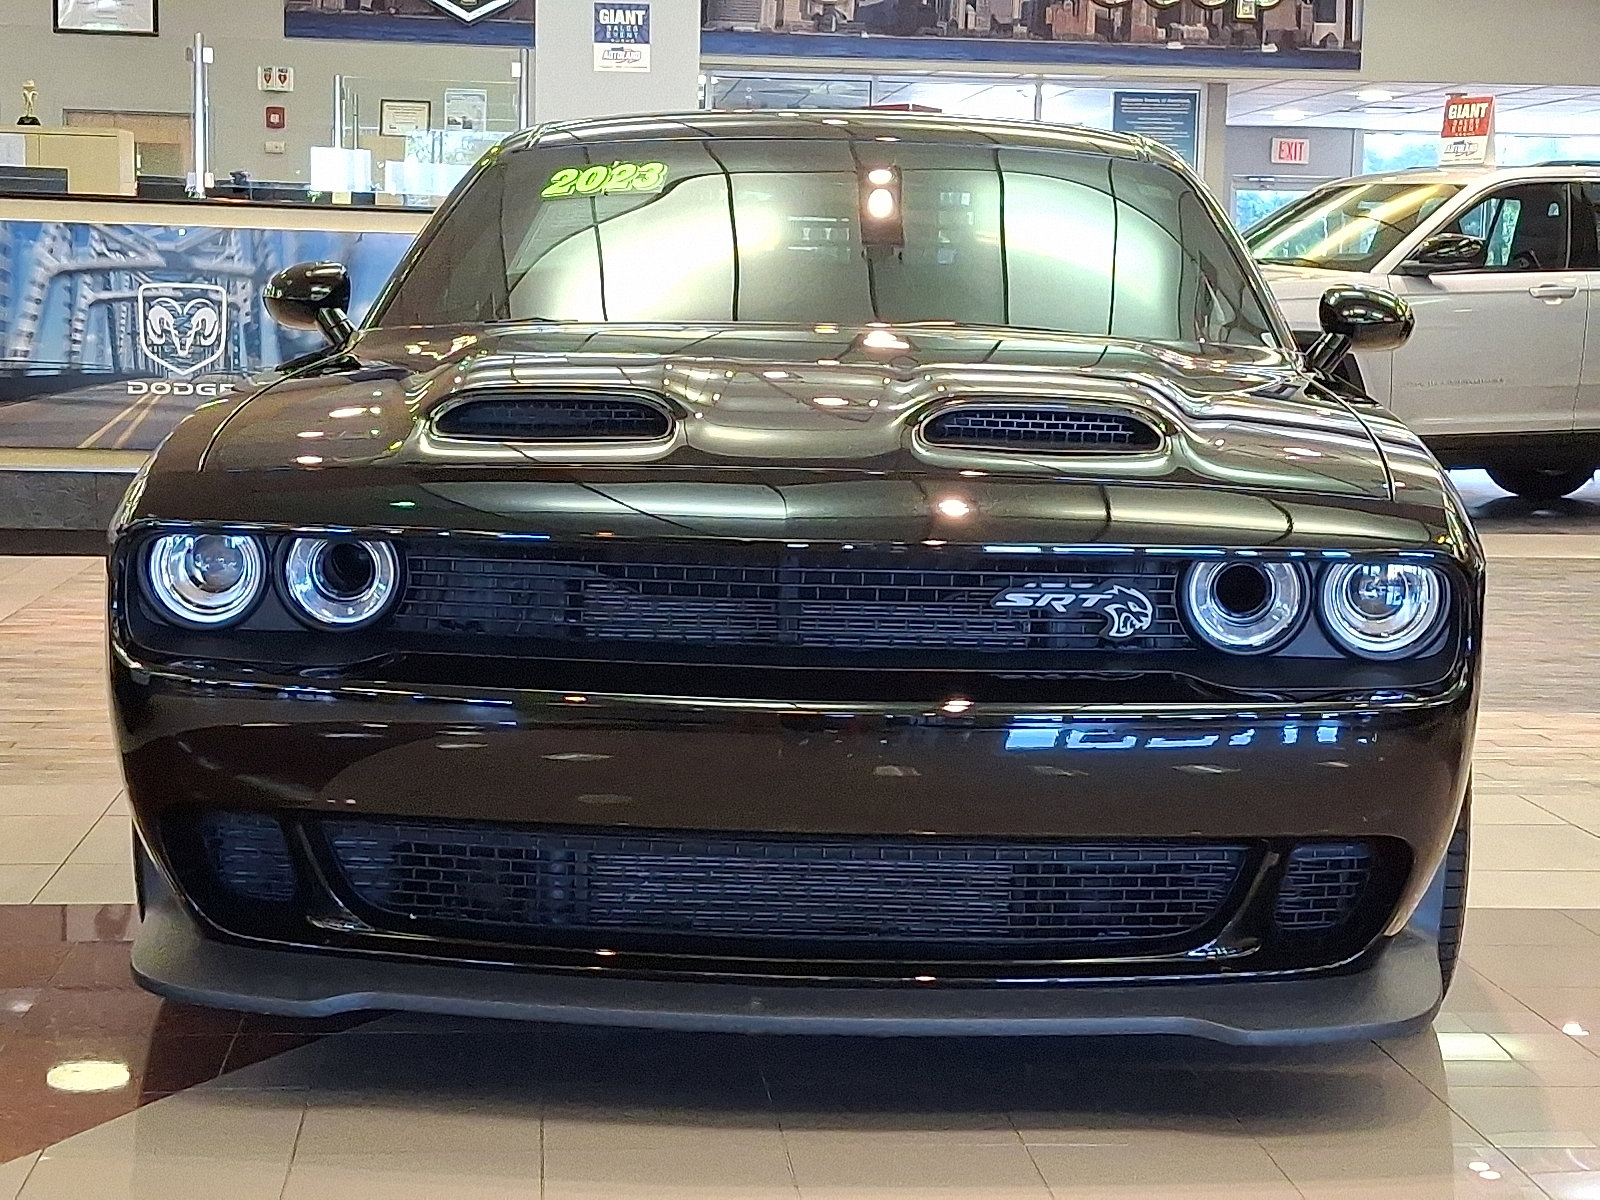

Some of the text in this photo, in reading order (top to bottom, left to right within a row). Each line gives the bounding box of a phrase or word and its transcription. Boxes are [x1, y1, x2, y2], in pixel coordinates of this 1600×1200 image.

[599, 9, 646, 25] GIANT
[1448, 103, 1489, 119] GIANT
[1278, 141, 1305, 161] EXIT
[540, 161, 669, 198] 2023
[995, 593, 1114, 613] SRT
